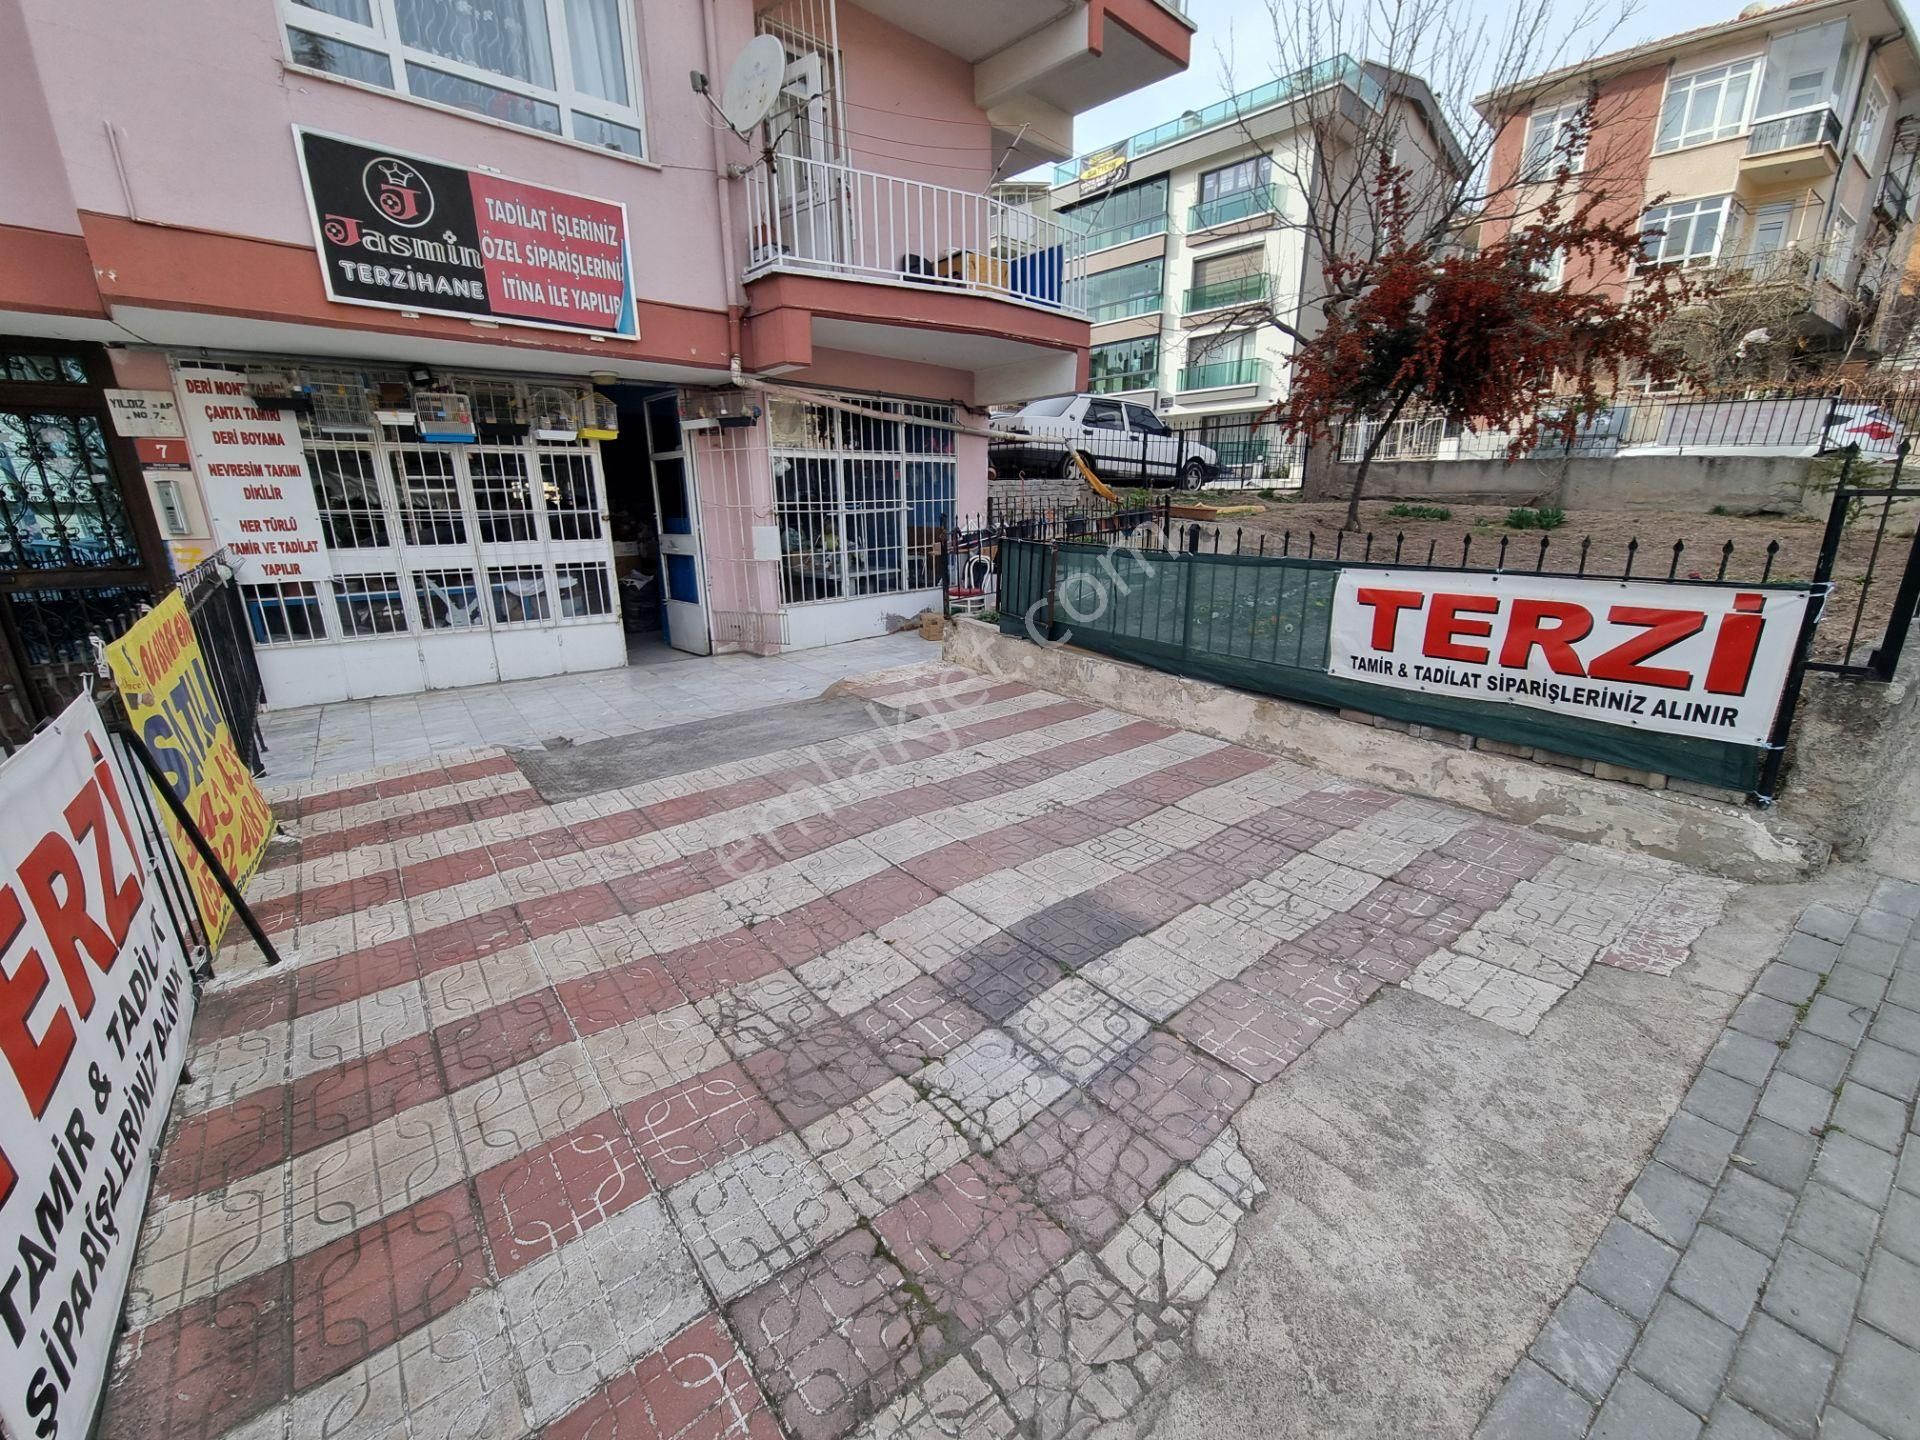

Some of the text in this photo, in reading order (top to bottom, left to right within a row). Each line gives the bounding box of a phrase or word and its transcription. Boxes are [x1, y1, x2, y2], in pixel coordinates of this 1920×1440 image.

[485, 197, 618, 247] TADİLAT İŞLERİNİZ
[324, 213, 485, 270] Jasmin
[481, 229, 623, 282] ÖZEL SİPARİŞLERİNİ
[338, 260, 485, 300] TERZİHANE
[501, 270, 545, 305] İTİNA
[547, 278, 569, 309] İLE
[185, 376, 213, 394] DERİ
[109, 398, 147, 409] YILDIZ
[205, 405, 243, 422] ÇANTA
[212, 429, 285, 446] DERİ BOYAMA
[155, 444, 168, 459] 7
[208, 461, 301, 477] NEVRESİM TAKIMI
[243, 484, 283, 500] DİKİLİR
[240, 516, 298, 532] HER TÜRLÜ
[228, 540, 318, 555] TAMİR VE TADİLAT
[261, 563, 302, 576] YAPILIR
[1356, 587, 1768, 696] TERZİ
[1350, 655, 1739, 728] TAMİR & TADİLAT SİPARİŞLERİNİZ ALINIR
[0, 730, 145, 1207] ERZİ
[0, 1107, 96, 1350] TAMİR
[88, 1061, 112, 1115] &
